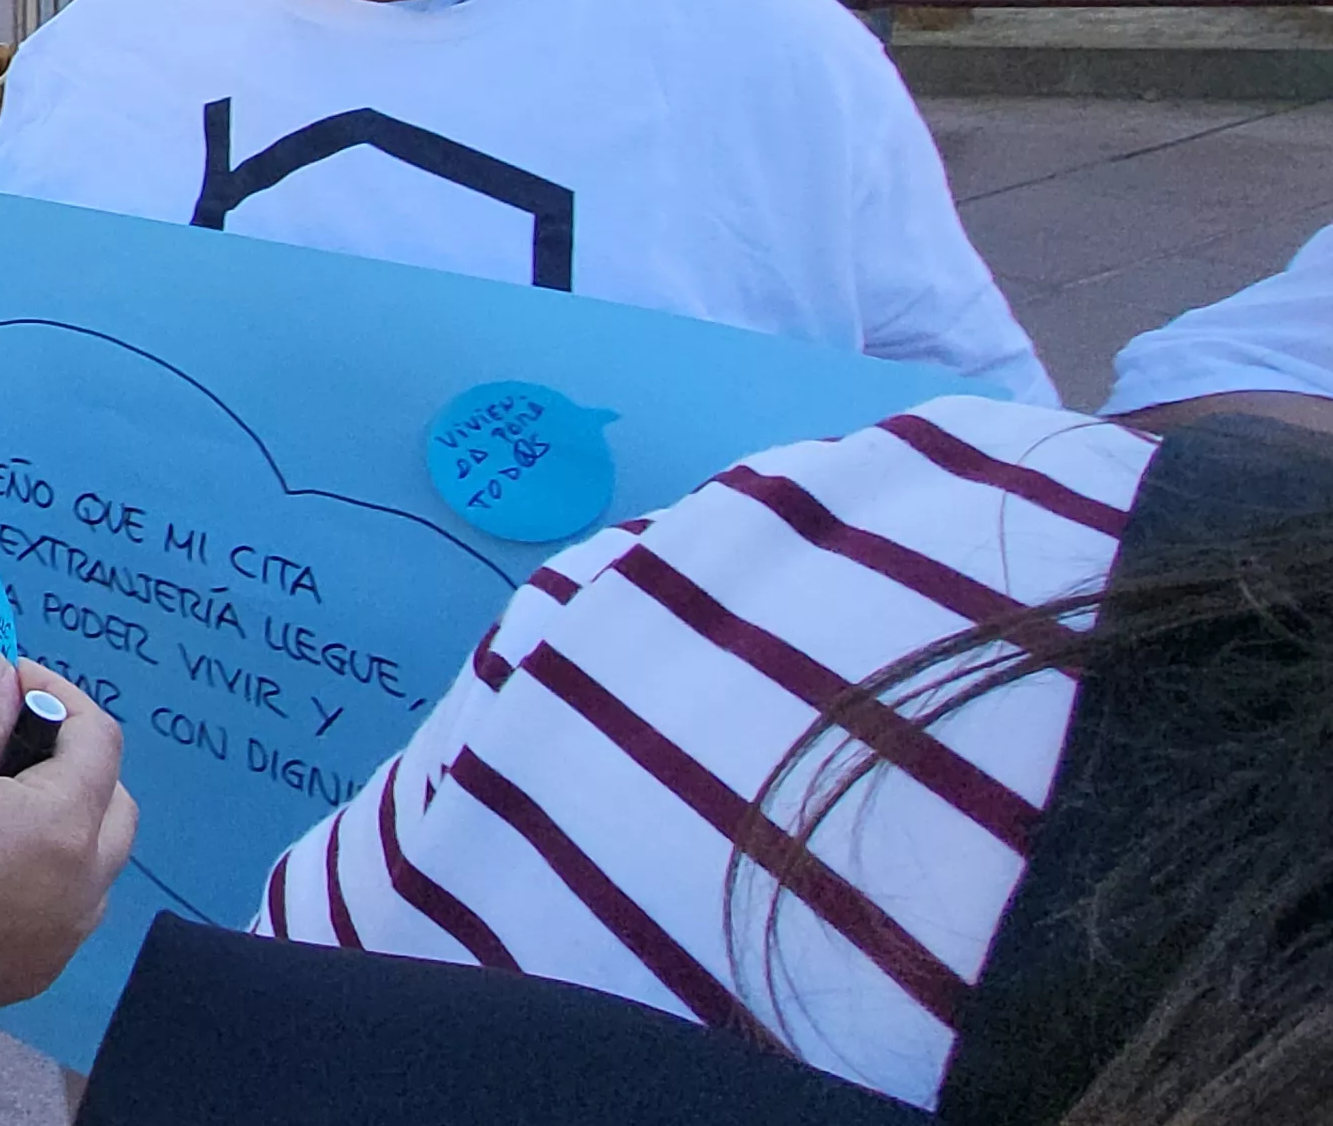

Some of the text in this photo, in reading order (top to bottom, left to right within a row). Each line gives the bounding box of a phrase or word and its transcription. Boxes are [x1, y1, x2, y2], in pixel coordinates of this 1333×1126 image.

[72, 491, 147, 544] QUE
[163, 522, 207, 565] MI
[229, 544, 322, 605] CITA
[42, 591, 160, 666] PODER
[177, 642, 289, 719] VIVIR
[310, 695, 345, 737] Y
[150, 706, 363, 807] CON DIGNI
